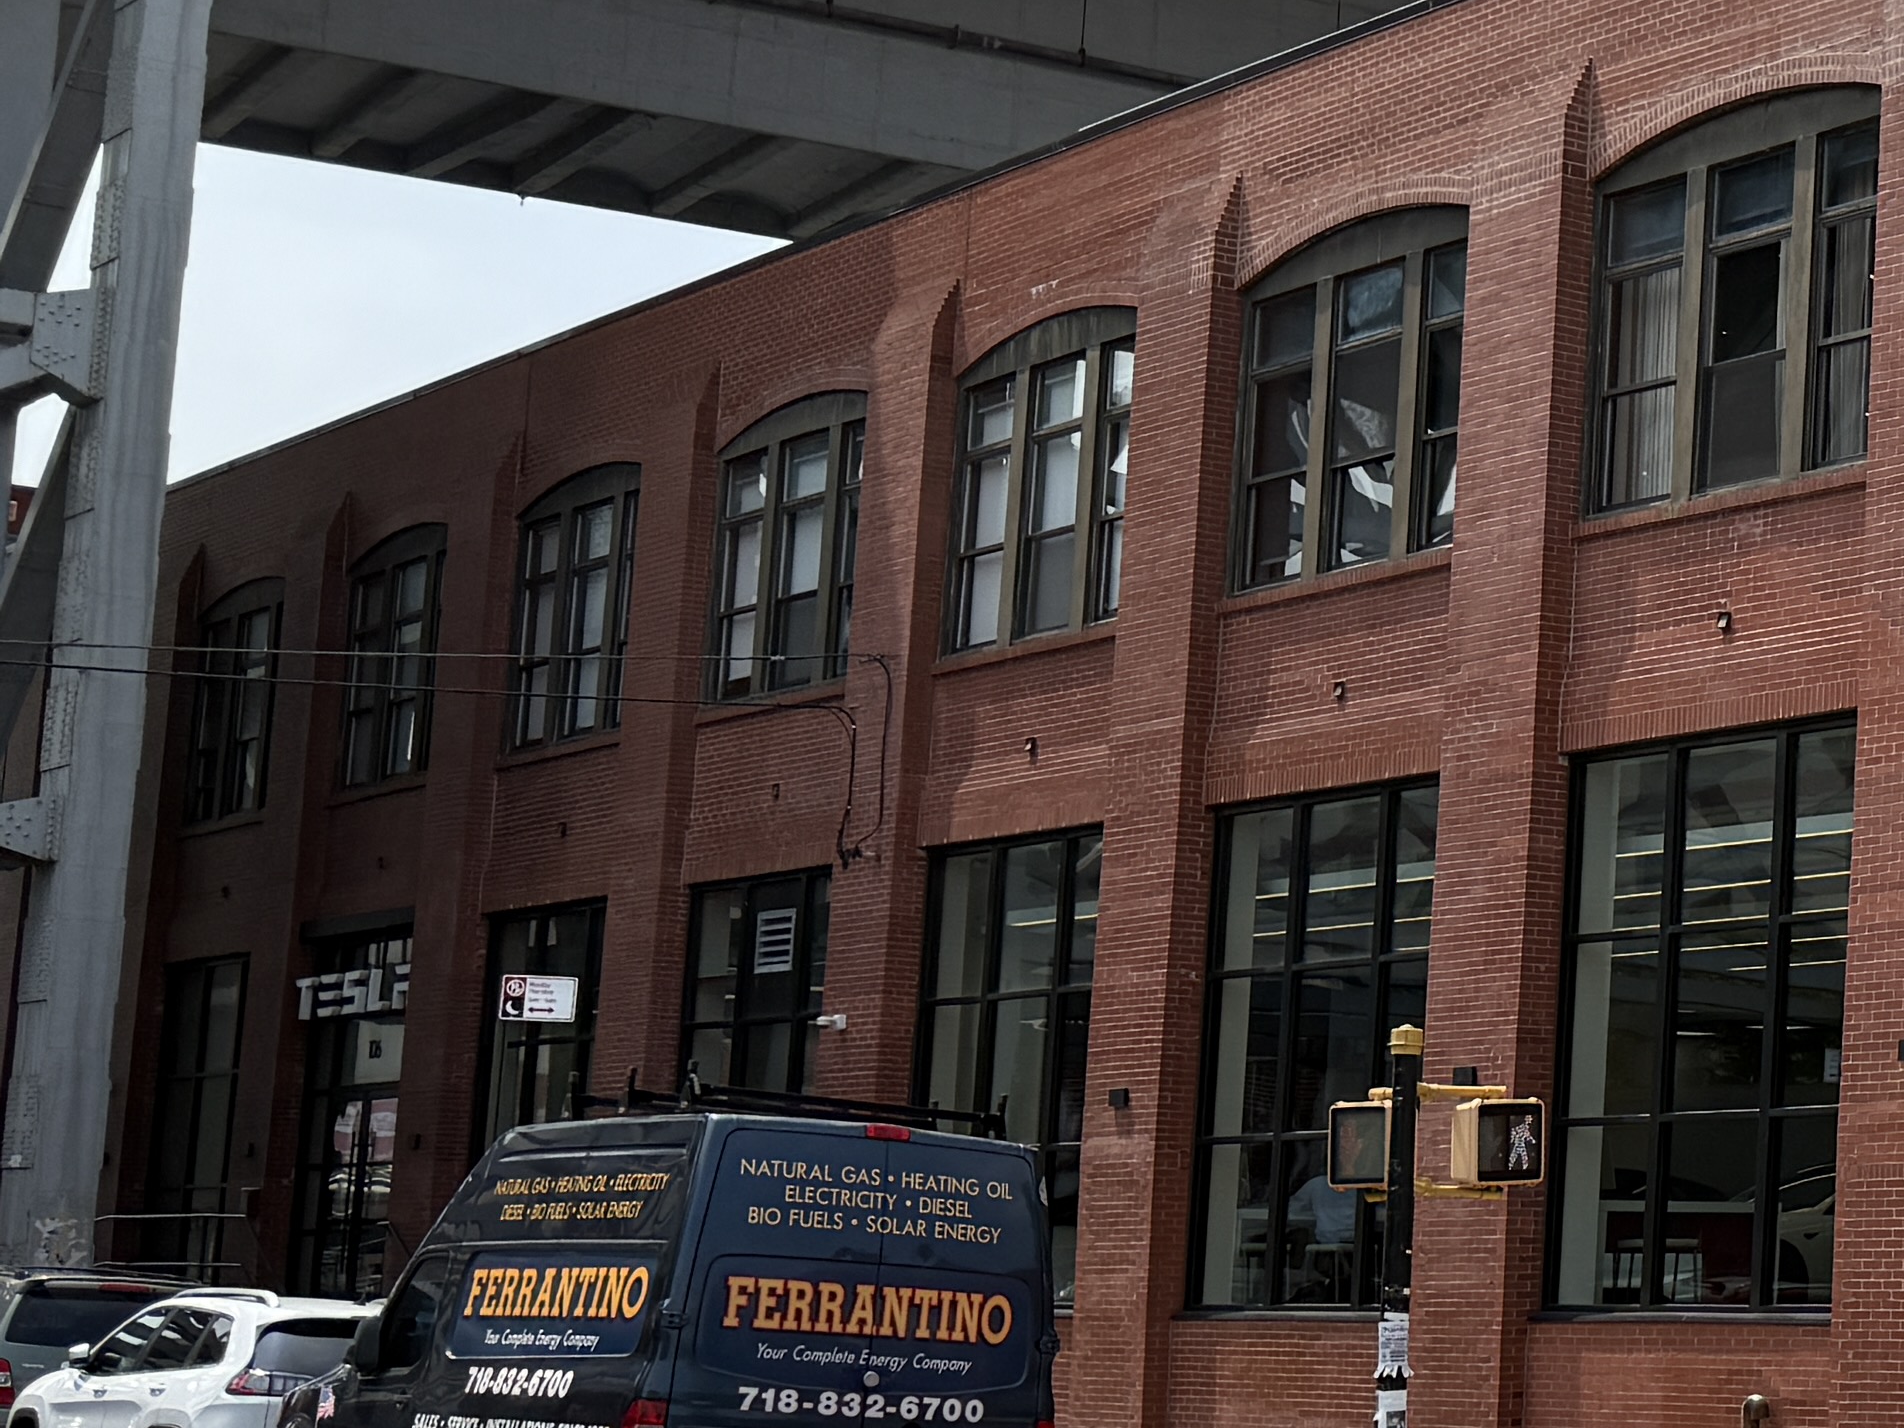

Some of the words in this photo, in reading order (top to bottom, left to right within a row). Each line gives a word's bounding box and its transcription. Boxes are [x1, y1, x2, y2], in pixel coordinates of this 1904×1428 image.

[494, 1177, 530, 1195] NATURAL
[531, 1176, 551, 1194] GAS
[740, 1158, 834, 1183] NATURAL
[841, 1166, 881, 1186] GAS
[902, 1171, 980, 1197] HEATING
[986, 1181, 1013, 1200] OIL
[785, 1184, 897, 1211] ELECTRICITY
[919, 1197, 972, 1219] DIESEL
[748, 1206, 782, 1226] BIO
[788, 1209, 843, 1231] FUELS
[866, 1215, 926, 1237] SOLAR
[934, 1221, 1001, 1245] ENERGY
[463, 1266, 649, 1319] FERRANTINO
[722, 1275, 1013, 1345] FERRANTINO
[757, 1342, 787, 1360] Your
[792, 1344, 855, 1366] Complete
[859, 1349, 908, 1372] Energy
[912, 1352, 972, 1376] Company
[464, 1366, 574, 1398] 718-832-6700
[738, 1386, 985, 1423] 718-832-6700
